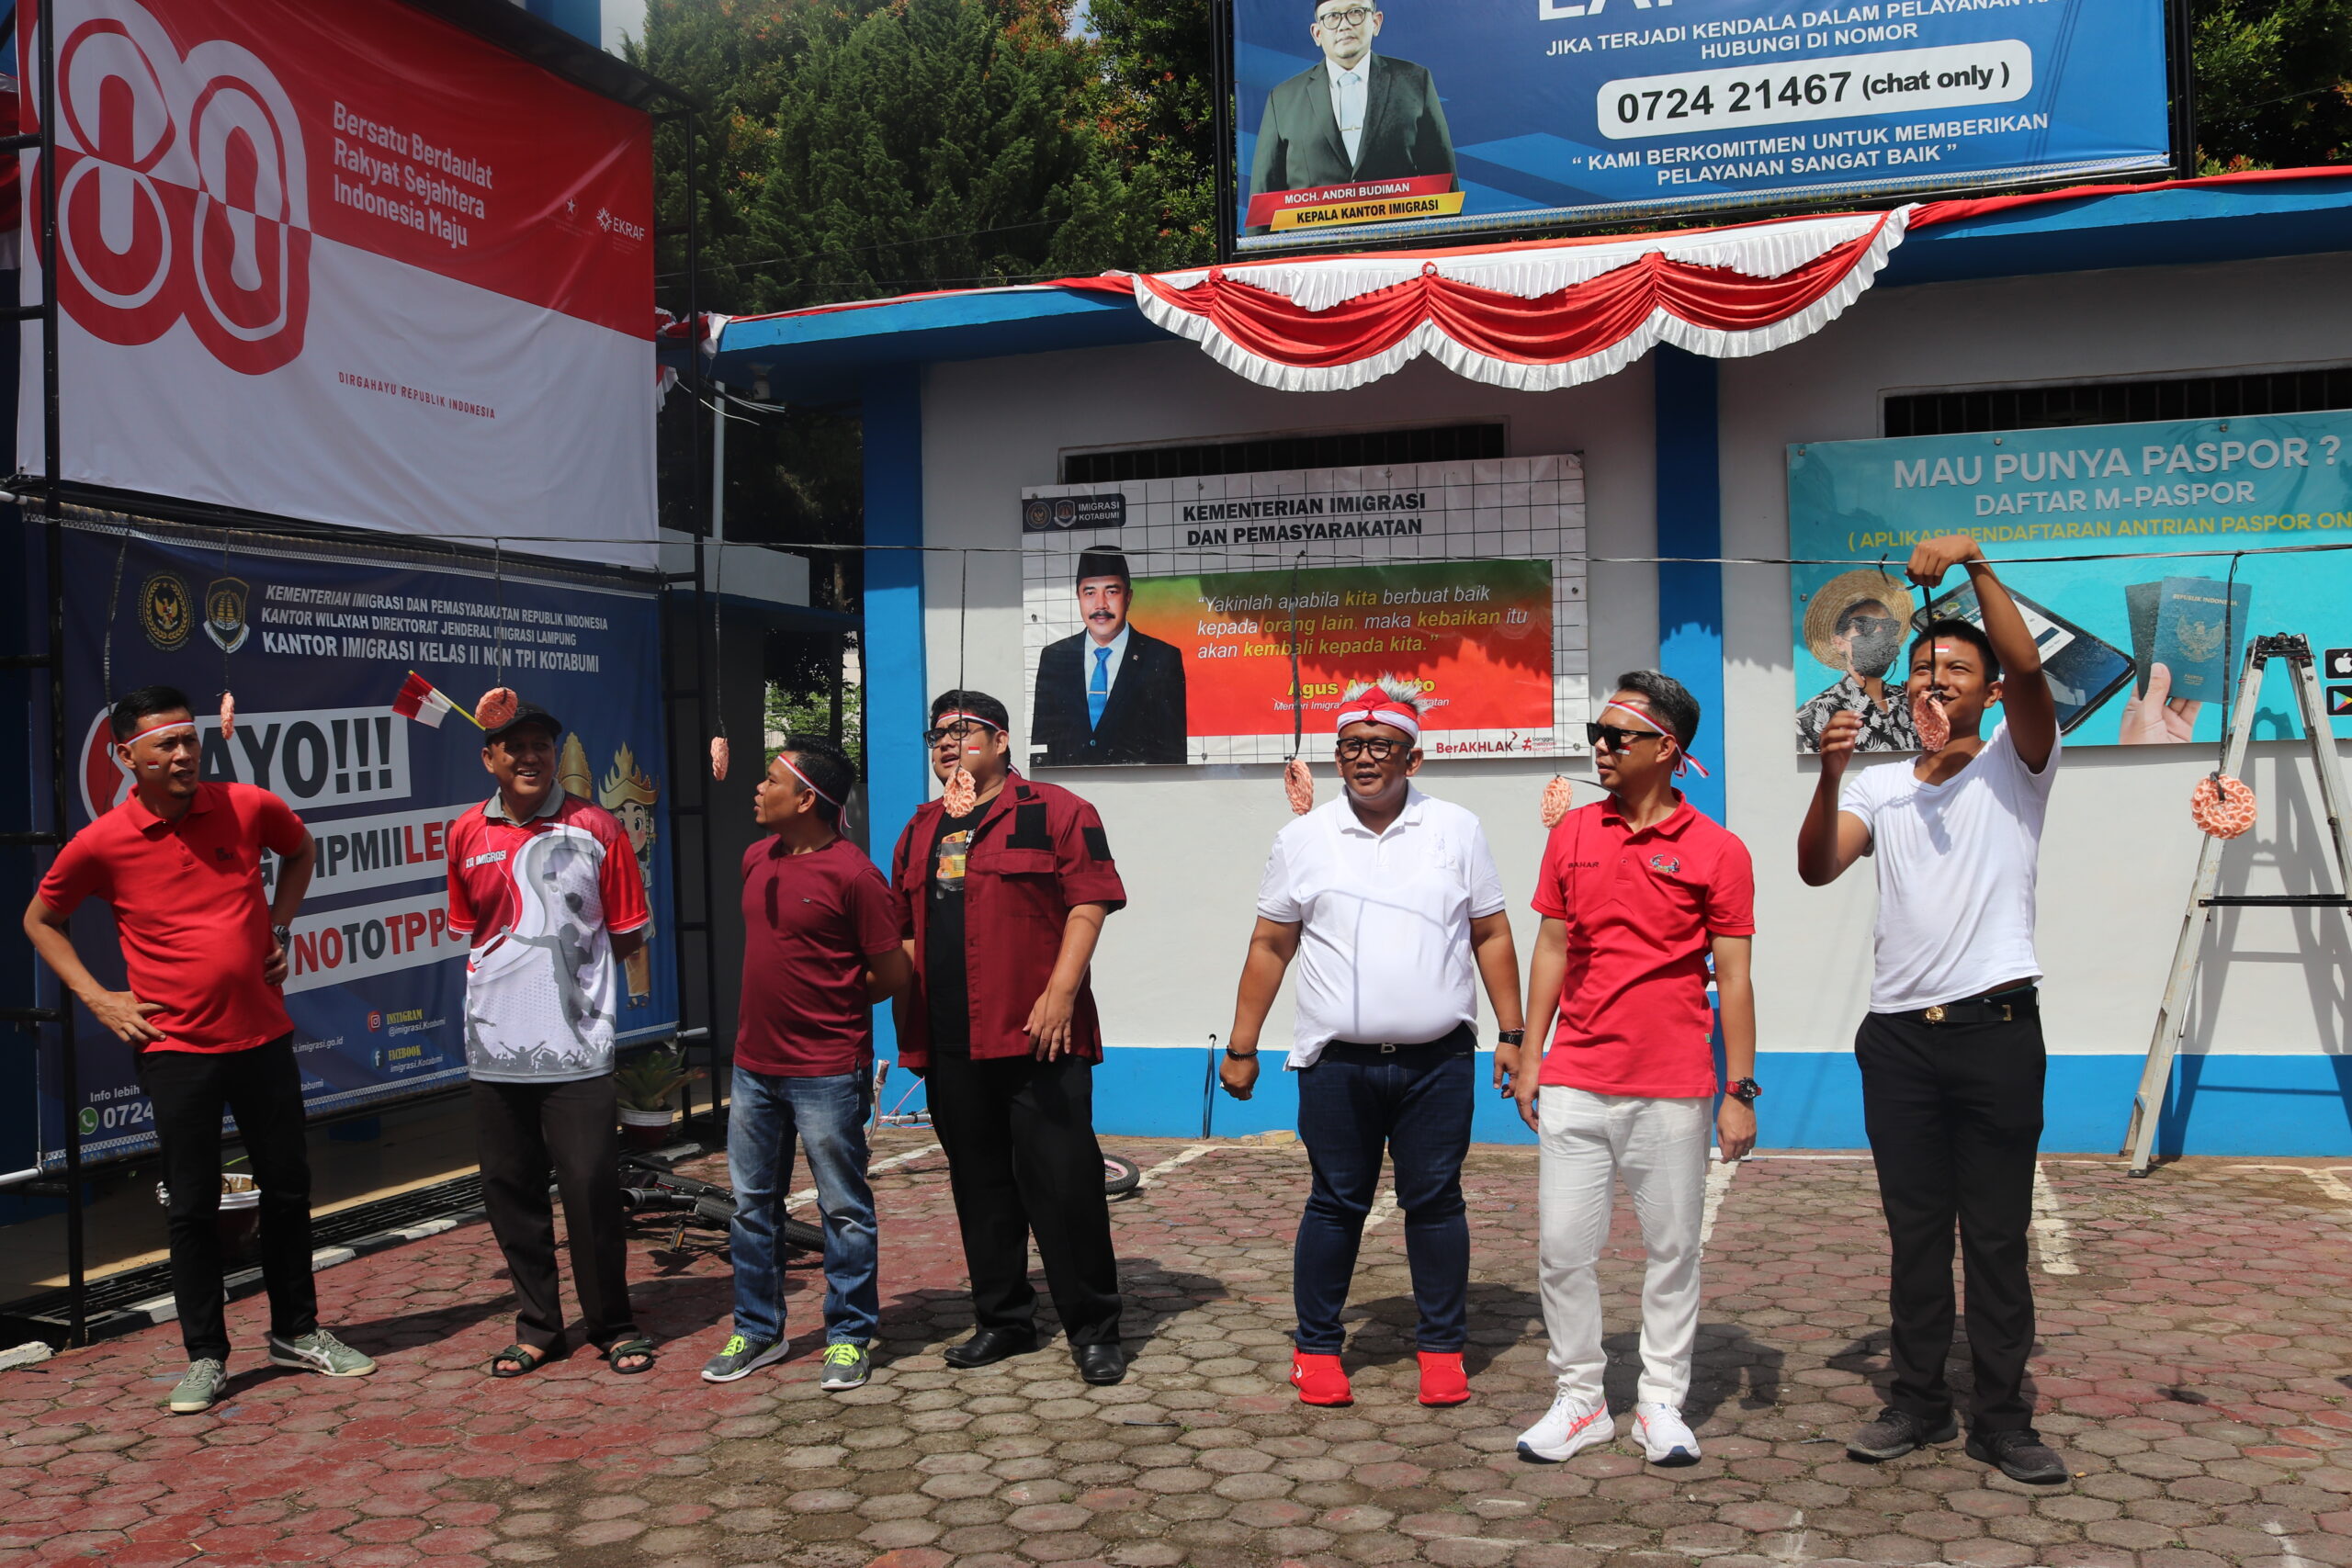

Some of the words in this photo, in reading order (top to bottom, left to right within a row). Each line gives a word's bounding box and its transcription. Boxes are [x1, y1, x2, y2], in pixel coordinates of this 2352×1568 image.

[1546, 38, 1592, 56] JIKA
[1598, 26, 1685, 50] TERJADI
[1693, 14, 1796, 39] KENDALA
[1803, 5, 1879, 28] DALAM
[1702, 35, 1800, 60] HUBUNGI
[1806, 31, 1826, 49] DI
[1835, 22, 1918, 45] NOMOR
[1617, 85, 1714, 123] 0724
[1728, 72, 1851, 113] 21467
[1862, 69, 1930, 101] (chat
[1937, 64, 1994, 90] only
[334, 100, 407, 155] Bersatu
[413, 132, 492, 189] Berdaulat
[1588, 151, 1641, 171] KAMI
[1646, 135, 1806, 165] BERKOMITMEN
[1813, 127, 1888, 150] UNTUK
[1895, 112, 2048, 142] MEMBERIKAN
[334, 137, 400, 187] Rakyat
[404, 164, 485, 220] Sejahtera
[1657, 159, 1784, 186] PELAYANAN
[1791, 150, 1881, 175] SANGAT
[1887, 145, 1940, 165] BAIK
[1284, 194, 1319, 205] MOCH.
[1322, 189, 1355, 201] ANDRI
[1359, 182, 1410, 197] BUDIMAN
[334, 174, 424, 231] Indonesia
[429, 208, 468, 249] Maju
[1296, 209, 1339, 224] KEPALA
[1341, 204, 1385, 220] KANTOR
[1389, 199, 1439, 214] IMIGRASI
[614, 218, 645, 241] EKRAF
[339, 371, 397, 395] DIRGAHAYU
[401, 386, 446, 407] REPUBLIK
[448, 398, 495, 419] INDONESIA
[1894, 456, 1983, 489] MAU
[1996, 448, 2132, 484] PUNYA
[2143, 437, 2309, 476] PASPOR
[2319, 434, 2341, 466] ?
[1079, 502, 1119, 512] IMIGRASI
[1183, 498, 1323, 522] KEMENTERIAN
[1330, 492, 1425, 513] IMIGRASI
[1976, 490, 2086, 516] DAFTAR
[2095, 481, 2256, 511] M-PASPOR
[1079, 512, 1119, 522] KOTABUMI
[1187, 529, 1227, 546] DAN
[1233, 518, 1422, 544] PEMASYARAKATAN
[2117, 516, 2214, 536] ANTRIAN
[2222, 513, 2312, 533] PASPOR
[265, 584, 351, 607] KEMENTERIAN
[352, 593, 404, 610] IMIGRASI
[406, 597, 428, 613] DAN
[432, 599, 520, 621] PEMASYARAKATAN
[522, 608, 563, 626] REPUBLIK
[565, 614, 608, 631] INDONESIA
[1279, 592, 1340, 613] apabila
[1345, 590, 1377, 606] kita
[1383, 587, 1449, 605] berbuat
[1453, 584, 1490, 603] baik
[2203, 597, 2238, 606] INDONEIA
[261, 606, 312, 626] KANTOR
[315, 612, 369, 630] WILAYAH
[371, 615, 438, 634] DIREKTORAT
[441, 621, 492, 639] JENDERAL
[494, 626, 535, 643] IMIGRASI
[537, 630, 577, 647] LAMPUNG
[1198, 618, 1257, 638] kepada
[1264, 620, 1316, 636] orang
[1321, 615, 1358, 632] lain,
[1364, 612, 1411, 629] maka
[1417, 610, 1500, 627] kebaikan
[1506, 608, 1528, 624] itu
[263, 631, 338, 657] KANTOR
[342, 637, 415, 661] IMIGRASI
[419, 641, 467, 664] KELAS
[470, 645, 479, 665] II
[483, 646, 512, 667] NON
[515, 649, 536, 669] TPI
[539, 650, 599, 672] KOTABUMI
[1198, 642, 1238, 659] akan
[1243, 639, 1313, 657] kembali
[1318, 636, 1384, 658] kepada
[1436, 741, 1514, 753] BerAKHLAK
[386, 1009, 423, 1025] INSTAGRAM
[389, 1045, 422, 1061] FACEBOOK
[90, 1090, 111, 1102] Info
[114, 1084, 140, 1099] lebih
[103, 1100, 154, 1129] 0724
